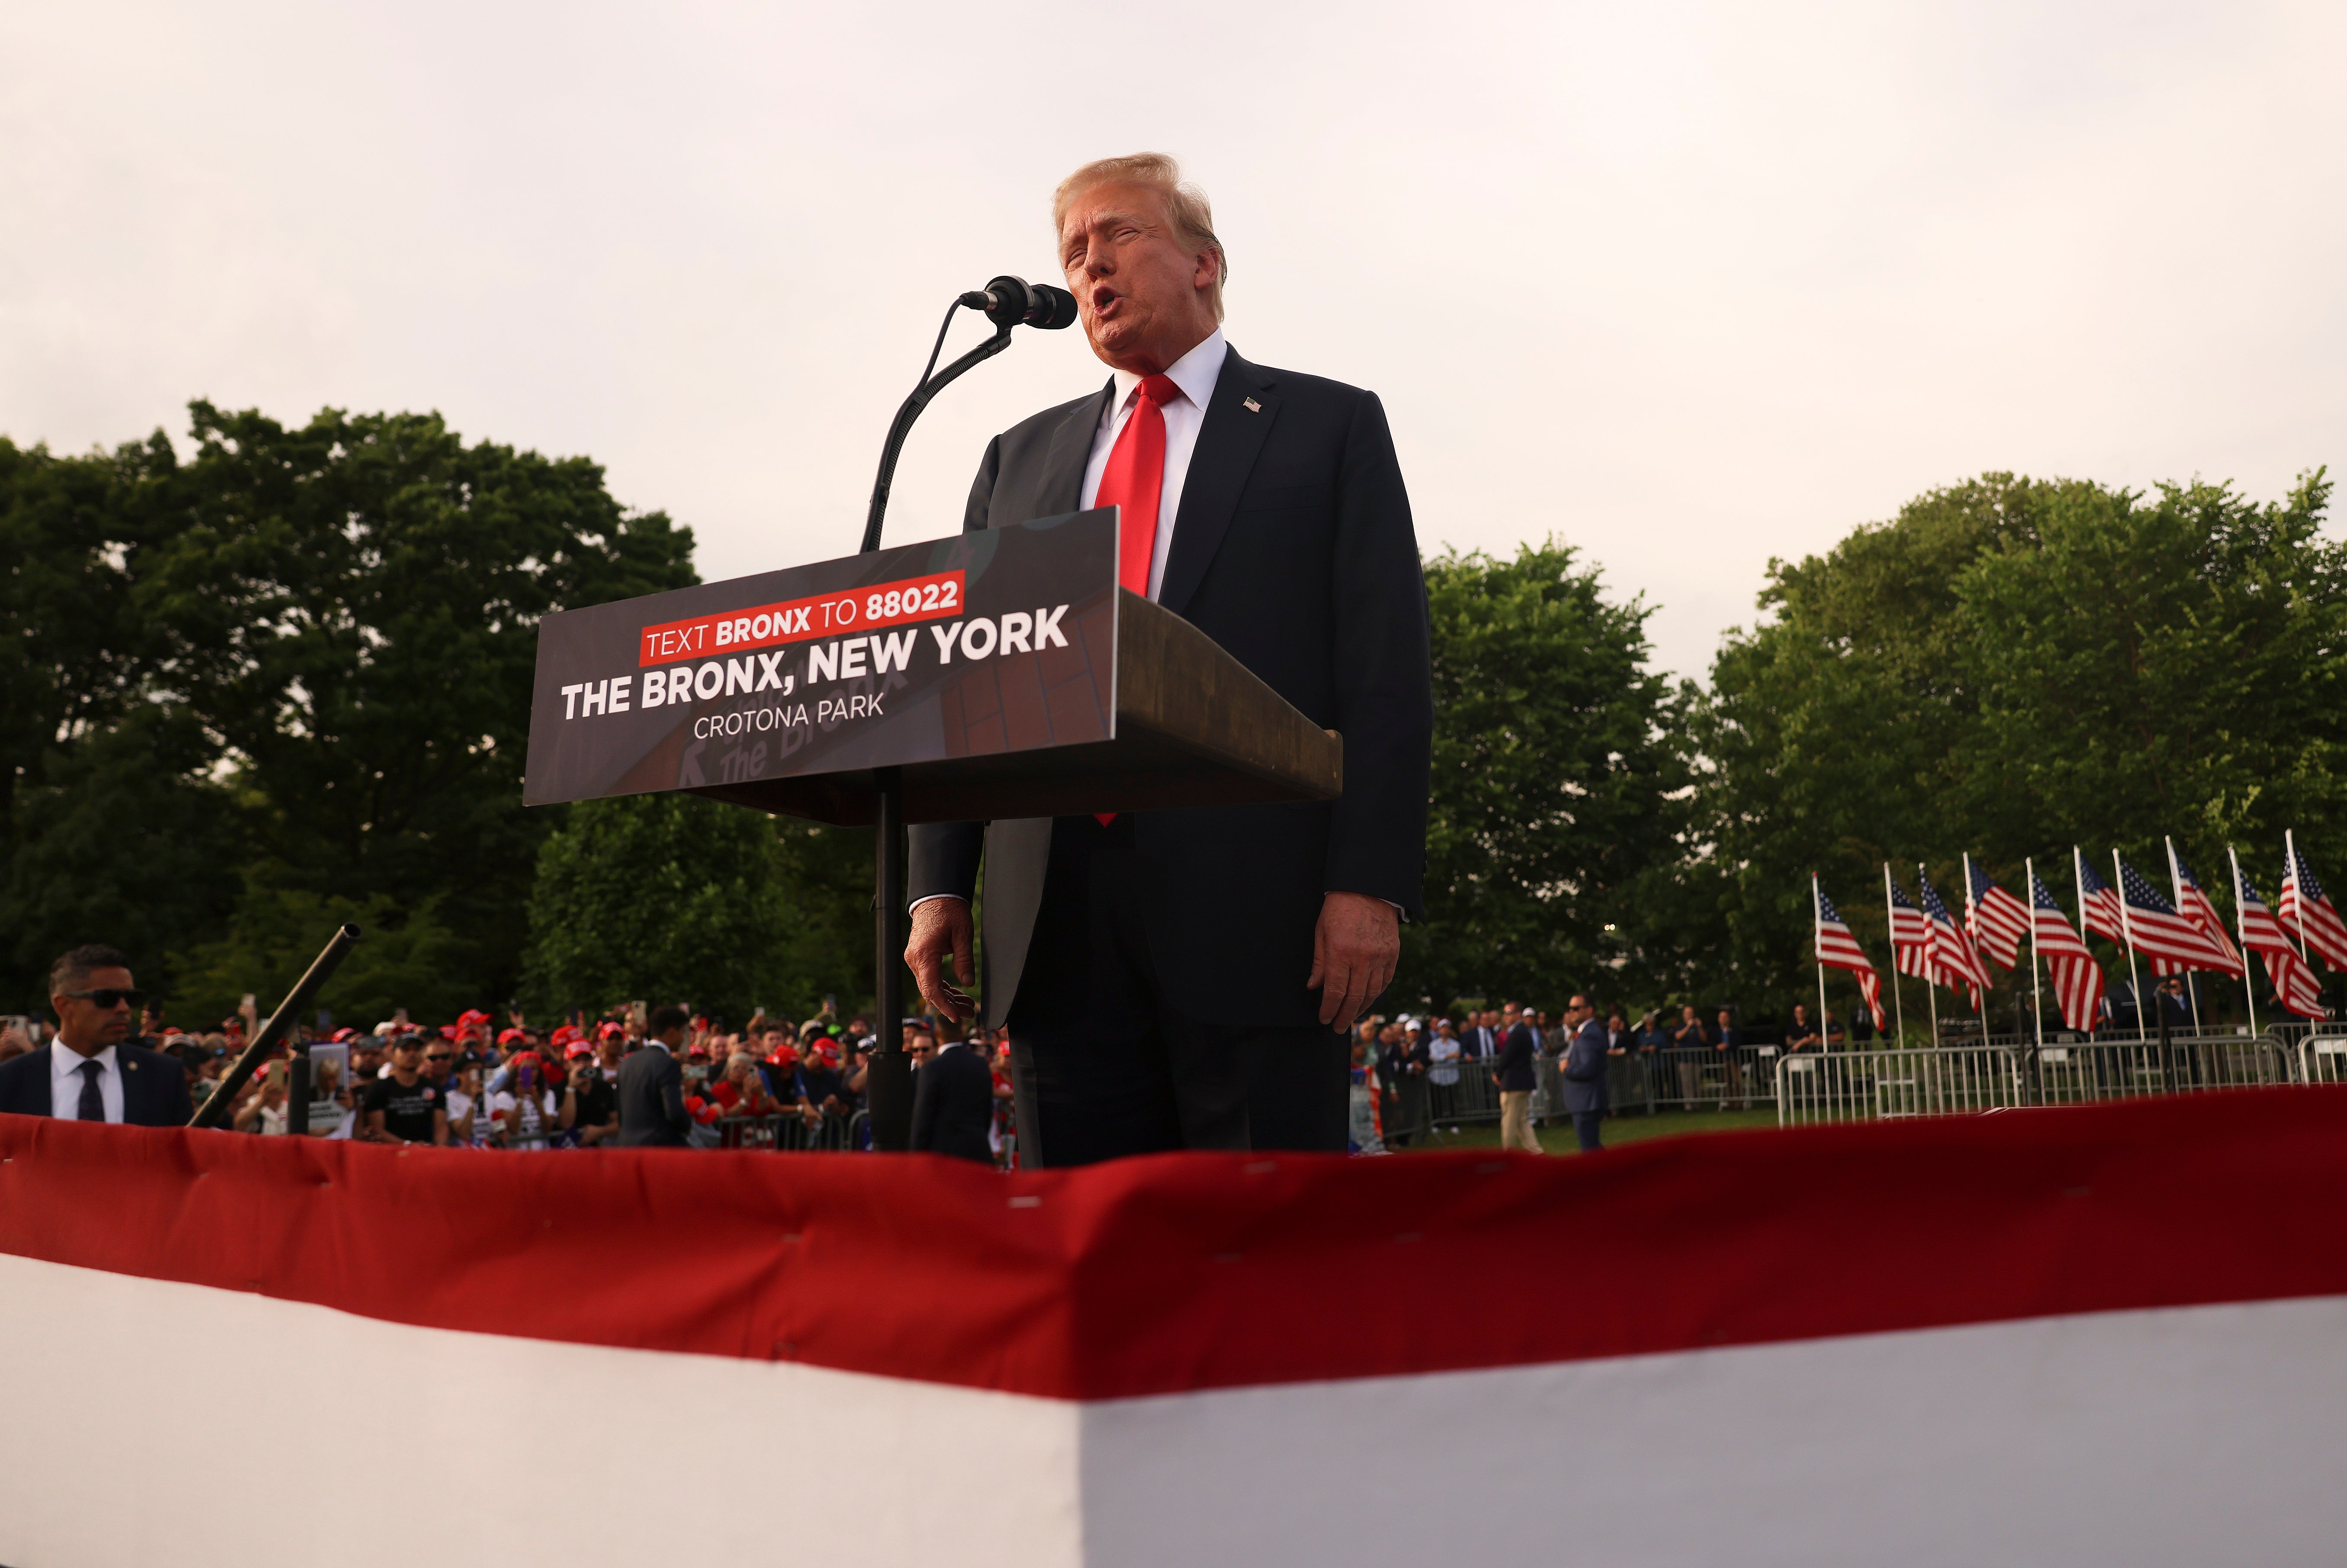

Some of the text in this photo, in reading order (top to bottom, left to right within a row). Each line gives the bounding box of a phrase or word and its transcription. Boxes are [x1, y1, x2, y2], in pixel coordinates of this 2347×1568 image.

[646, 580, 958, 657] TEXT BRONX TO 88022
[560, 604, 1070, 721] THE BRONX, NEW YORK
[694, 692, 885, 740] CROTONA PARK
[720, 741, 768, 784] The
